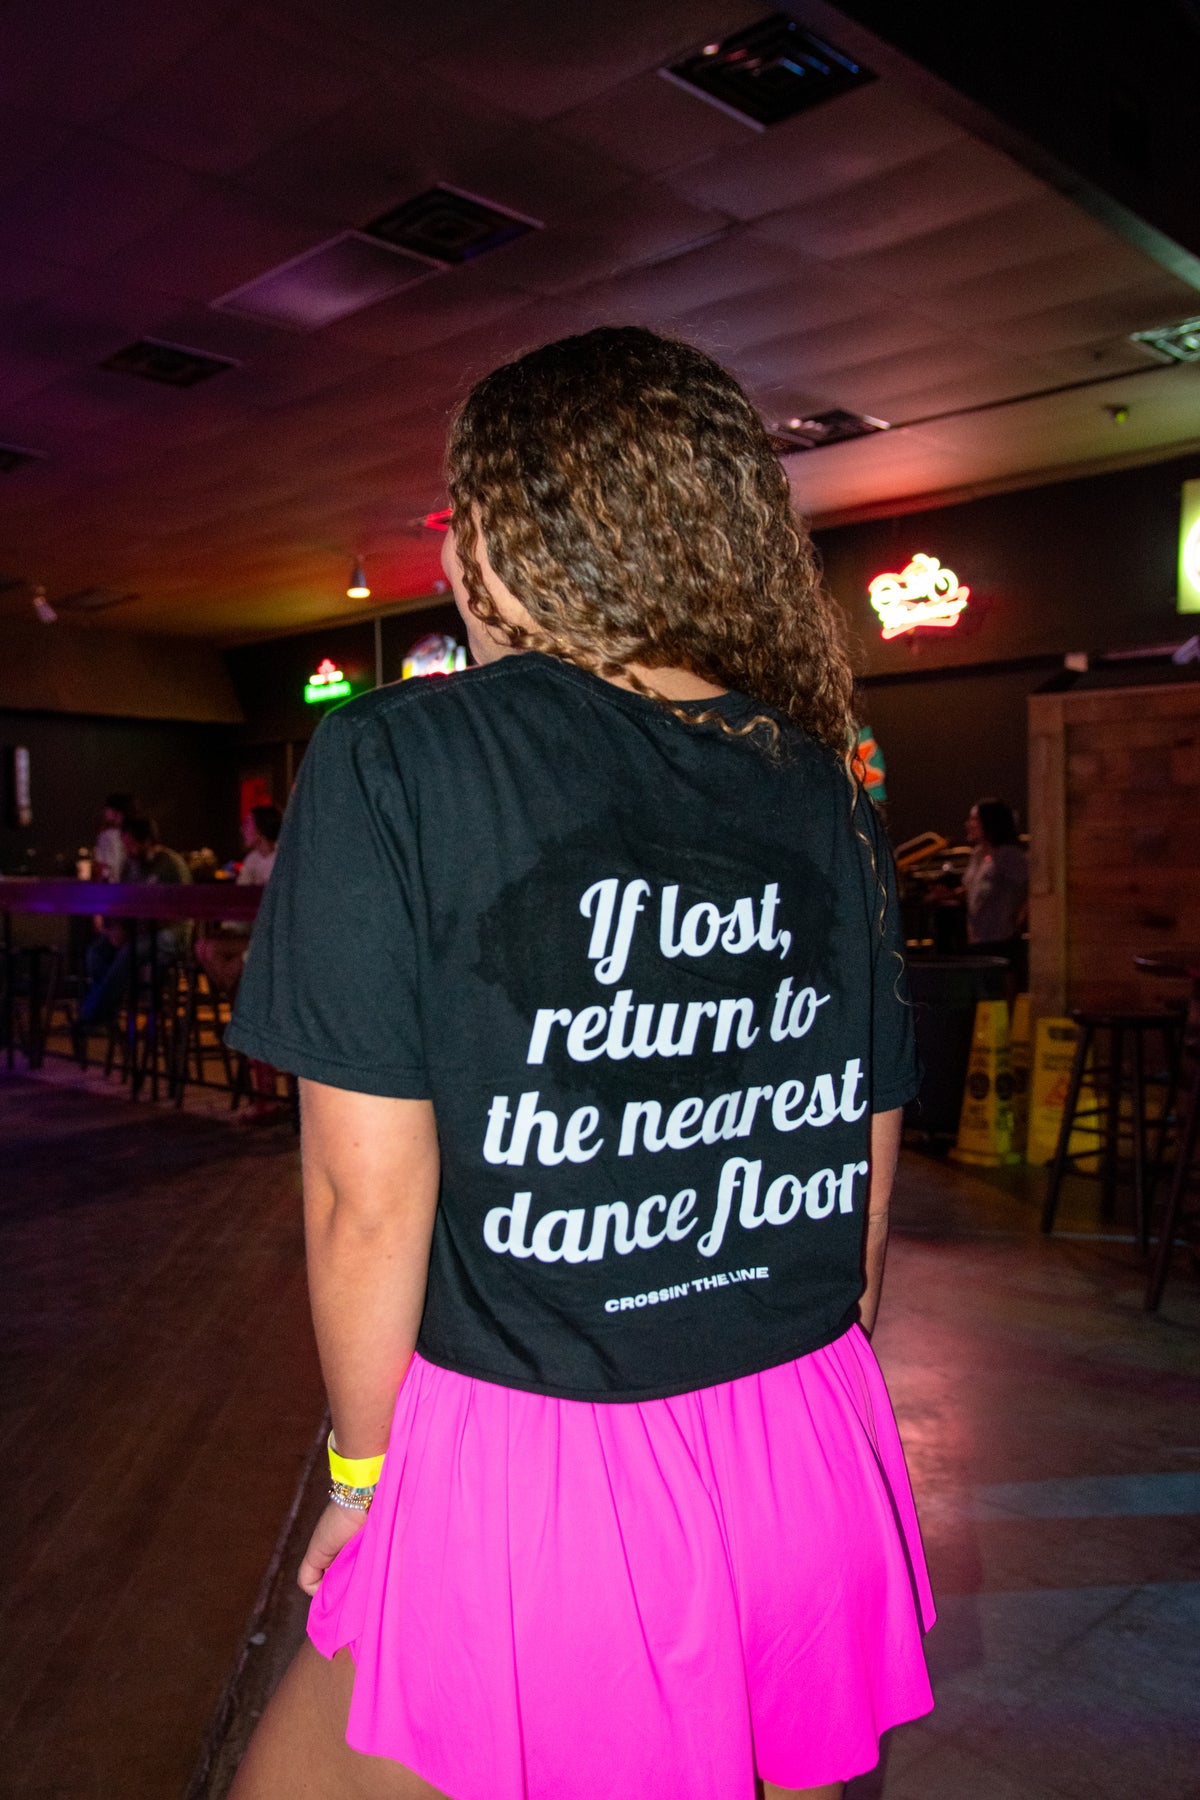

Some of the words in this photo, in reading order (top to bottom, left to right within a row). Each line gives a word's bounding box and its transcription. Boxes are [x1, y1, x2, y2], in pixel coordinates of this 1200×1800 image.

[579, 877, 652, 985] If
[659, 882, 792, 960] lost,
[526, 989, 760, 1065] return
[769, 976, 831, 1042] to
[482, 1090, 604, 1166] the
[617, 1057, 868, 1157] nearest
[483, 1188, 699, 1264] dance
[697, 1156, 869, 1258] floor
[604, 1282, 690, 1313] CROSSIN'
[691, 1273, 730, 1293] THE
[728, 1266, 770, 1283] LINE
